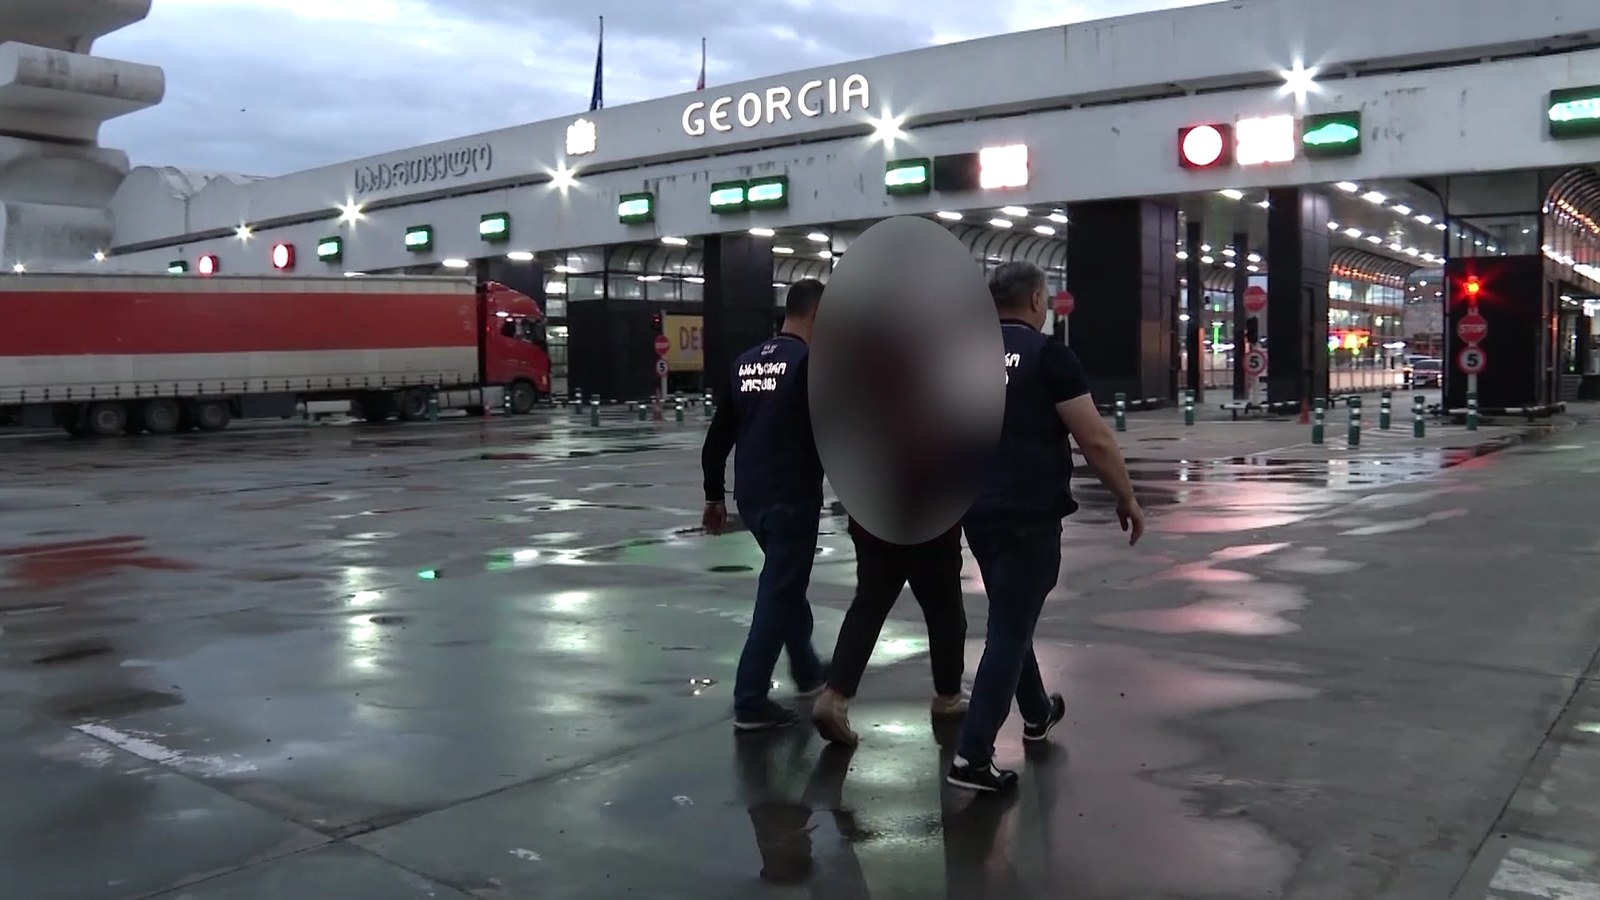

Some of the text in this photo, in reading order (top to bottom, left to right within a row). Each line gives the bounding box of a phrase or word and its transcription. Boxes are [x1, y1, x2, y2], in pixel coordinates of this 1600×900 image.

[682, 74, 870, 136] GEORGIA
[680, 326, 704, 350] DE
[1248, 356, 1259, 369] 5
[1467, 354, 1478, 368] 5
